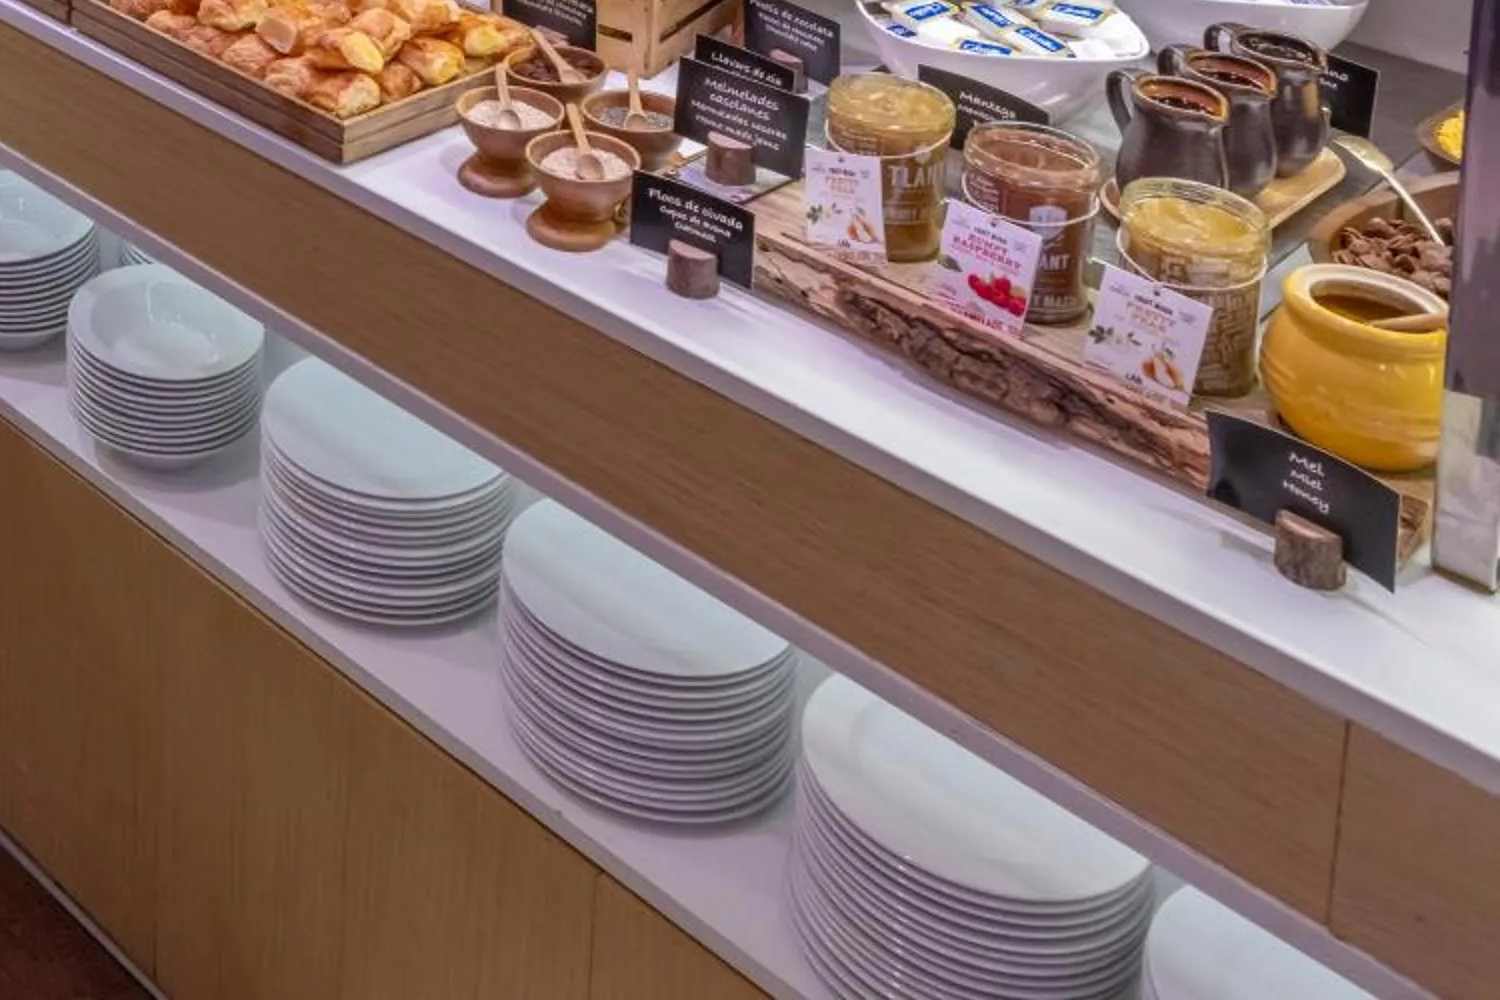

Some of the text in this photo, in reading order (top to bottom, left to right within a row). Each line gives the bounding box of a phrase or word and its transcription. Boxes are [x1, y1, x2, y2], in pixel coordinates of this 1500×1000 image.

[685, 200, 700, 214] de
[1288, 451, 1324, 477] Mel
[1283, 480, 1329, 514] Honey
